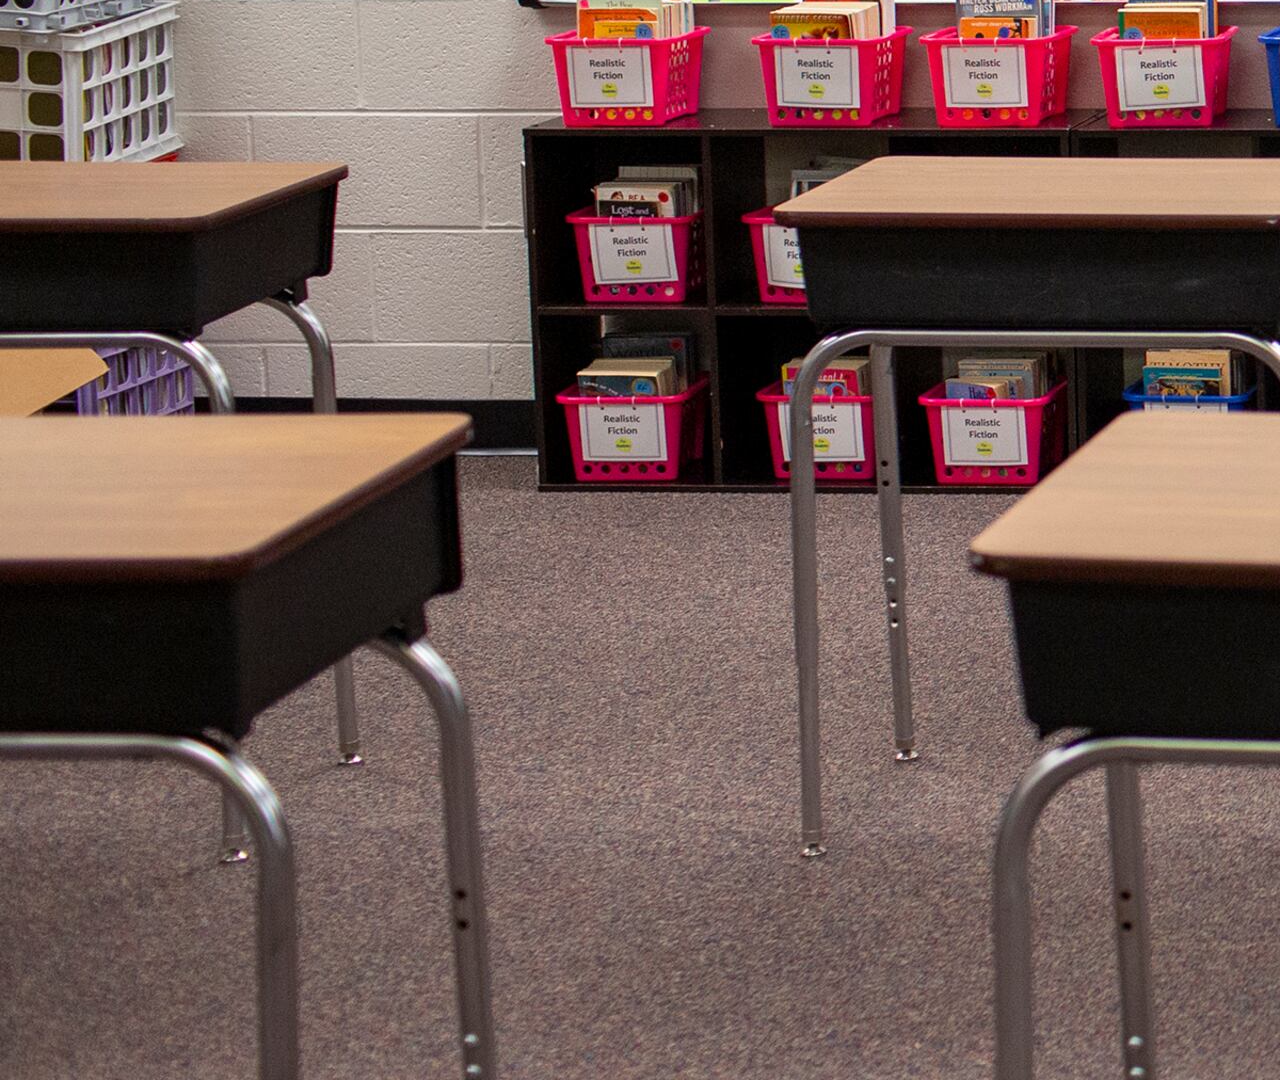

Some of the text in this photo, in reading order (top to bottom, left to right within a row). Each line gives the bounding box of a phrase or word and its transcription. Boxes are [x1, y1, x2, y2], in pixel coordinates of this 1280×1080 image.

[974, 4, 994, 13] ROSS
[589, 58, 626, 68] Realistic
[797, 59, 834, 68] Realistic
[965, 58, 1001, 68] Realistic
[1140, 59, 1178, 69] Realistic
[593, 71, 623, 80] Fiction
[801, 71, 831, 80] Fiction
[968, 71, 998, 80] Fiction
[1144, 71, 1175, 82] Fiction
[611, 204, 635, 216] Lost
[612, 235, 649, 245] Realistic
[617, 247, 647, 257] Fiction
[603, 414, 640, 423] Realistic
[812, 414, 838, 423] alistic
[964, 418, 1001, 428] Realistic
[608, 426, 638, 436] Fiction
[813, 426, 835, 435] ction
[969, 430, 999, 439] Fiction
